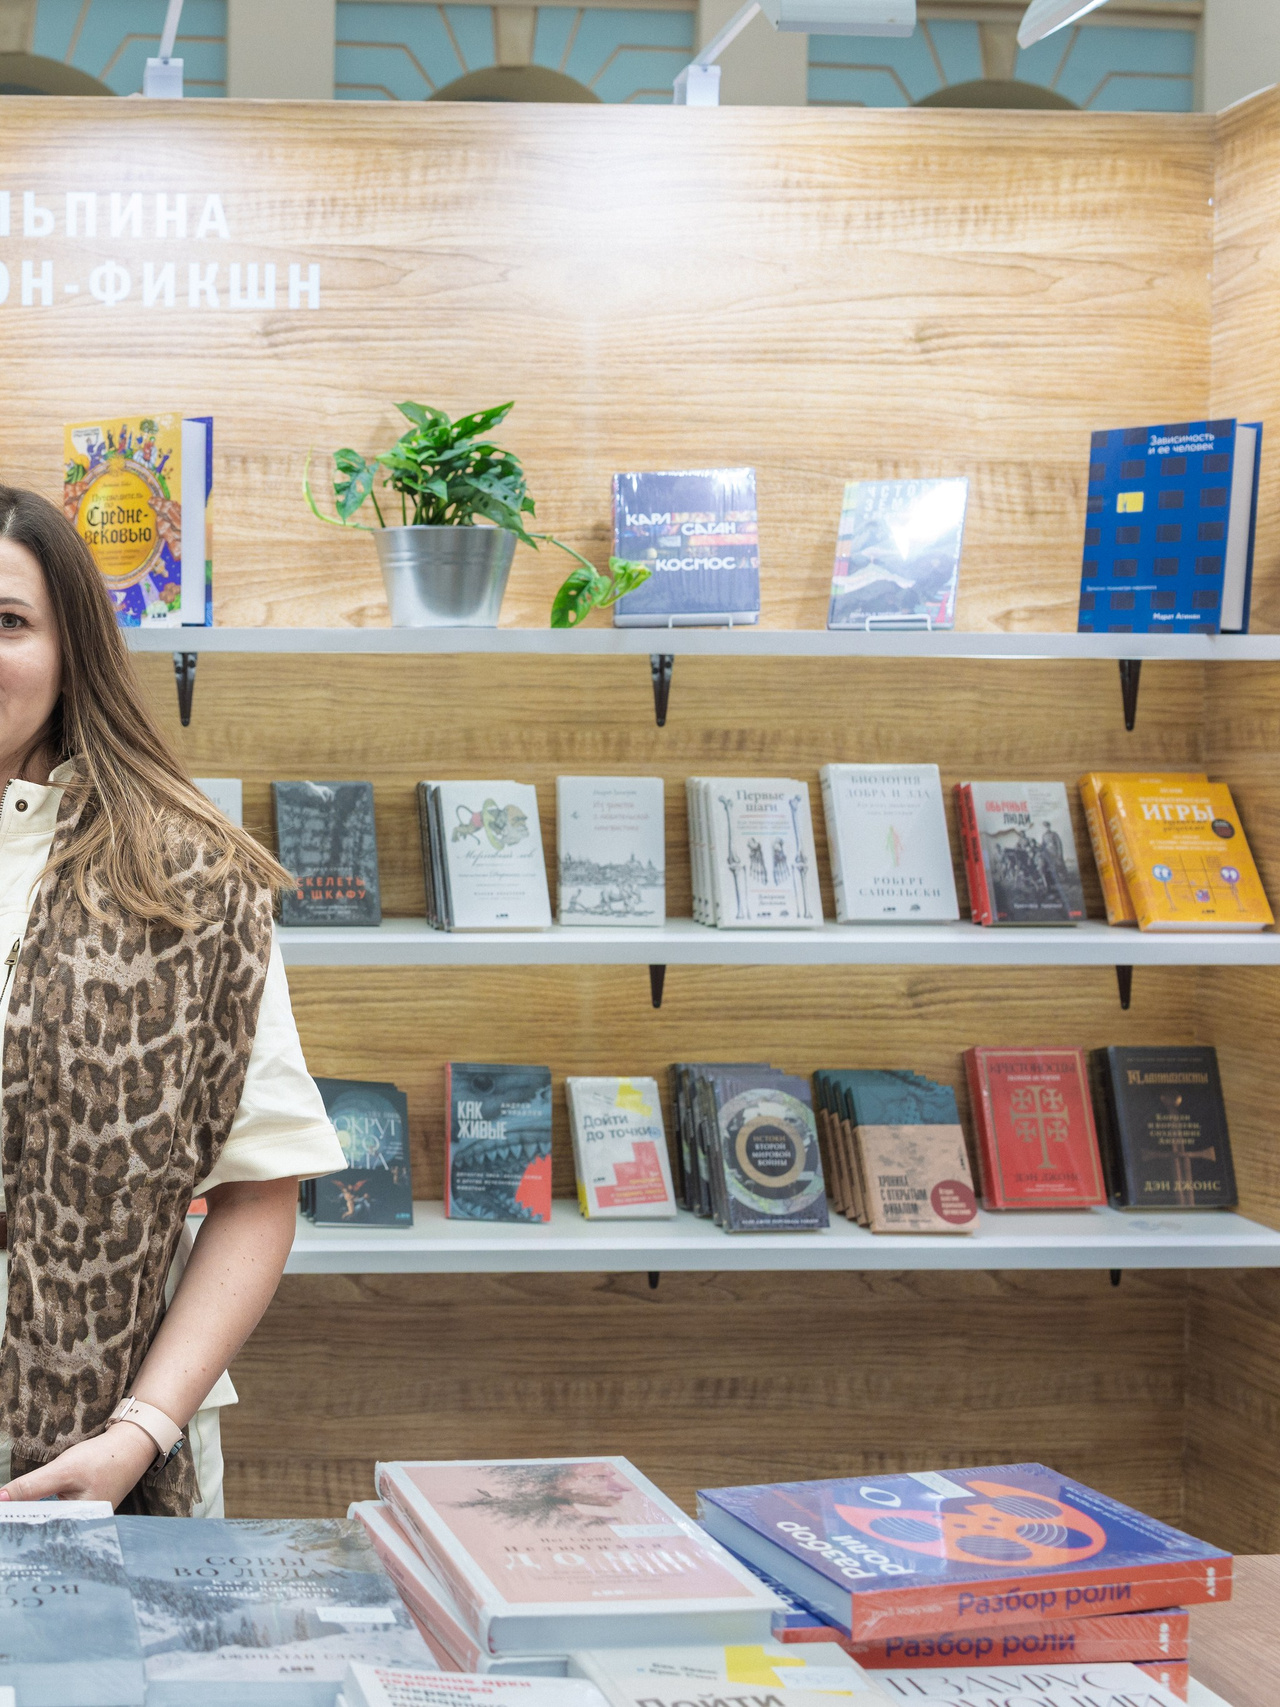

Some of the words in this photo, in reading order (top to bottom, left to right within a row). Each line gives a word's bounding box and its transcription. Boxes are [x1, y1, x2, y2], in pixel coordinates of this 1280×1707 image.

[1150, 433, 1215, 446] Зависимость
[1148, 446, 1155, 455] и
[1157, 446, 1170, 455] ее
[1173, 442, 1214, 453] человек
[87, 505, 149, 527] Средне-
[626, 512, 672, 526] КАРЛ
[681, 520, 736, 536] САГАН
[85, 527, 152, 545] вековью
[655, 556, 736, 572] КОСМОС
[851, 775, 921, 785] БИОЛОГИЯ
[737, 790, 784, 802] Первые
[848, 789, 886, 798] ДОБРА
[892, 789, 900, 798] И
[746, 803, 777, 812] шаги
[1141, 804, 1216, 822] ИГРЫ
[1004, 813, 1031, 825] ЛЮДИ
[297, 876, 366, 887] СКЕЛЕТЫ
[874, 877, 923, 885] РОБЕРТ
[297, 890, 304, 900] В
[311, 889, 366, 900] ШКАФУ
[859, 888, 941, 897] САПОЛЬСКИ
[990, 1063, 1076, 1073] КРЕСТОНОСЦЫ
[457, 1101, 483, 1119] КАК
[329, 1116, 401, 1139] ОКРУГ
[583, 1113, 628, 1130] Дойти
[457, 1120, 507, 1140] ЖИВЫЕ
[586, 1131, 604, 1142] до
[608, 1127, 651, 1139] точки
[755, 1142, 786, 1150] ВТОРОЙ
[752, 1150, 791, 1158] МИРОВОЙ
[1044, 1173, 1078, 1181] ДЖОНС
[1144, 1181, 1170, 1192] ДЭН
[1174, 1181, 1221, 1191] ДЖОНС
[776, 1521, 877, 1579] Разбор
[831, 1534, 916, 1575] роли
[205, 1556, 307, 1566] СОВЫ
[173, 1567, 219, 1577] ВО
[234, 1567, 347, 1579] ЛЬДАХ
[32, 1584, 79, 1594] ВО
[958, 1588, 1057, 1617] Разбор
[1065, 1582, 1132, 1609] роли
[886, 1633, 993, 1658] Разбор
[1002, 1631, 1075, 1656] роли
[375, 1669, 474, 1684] Создание
[379, 1678, 494, 1694] персонажа
[383, 1683, 472, 1700] Секреты
